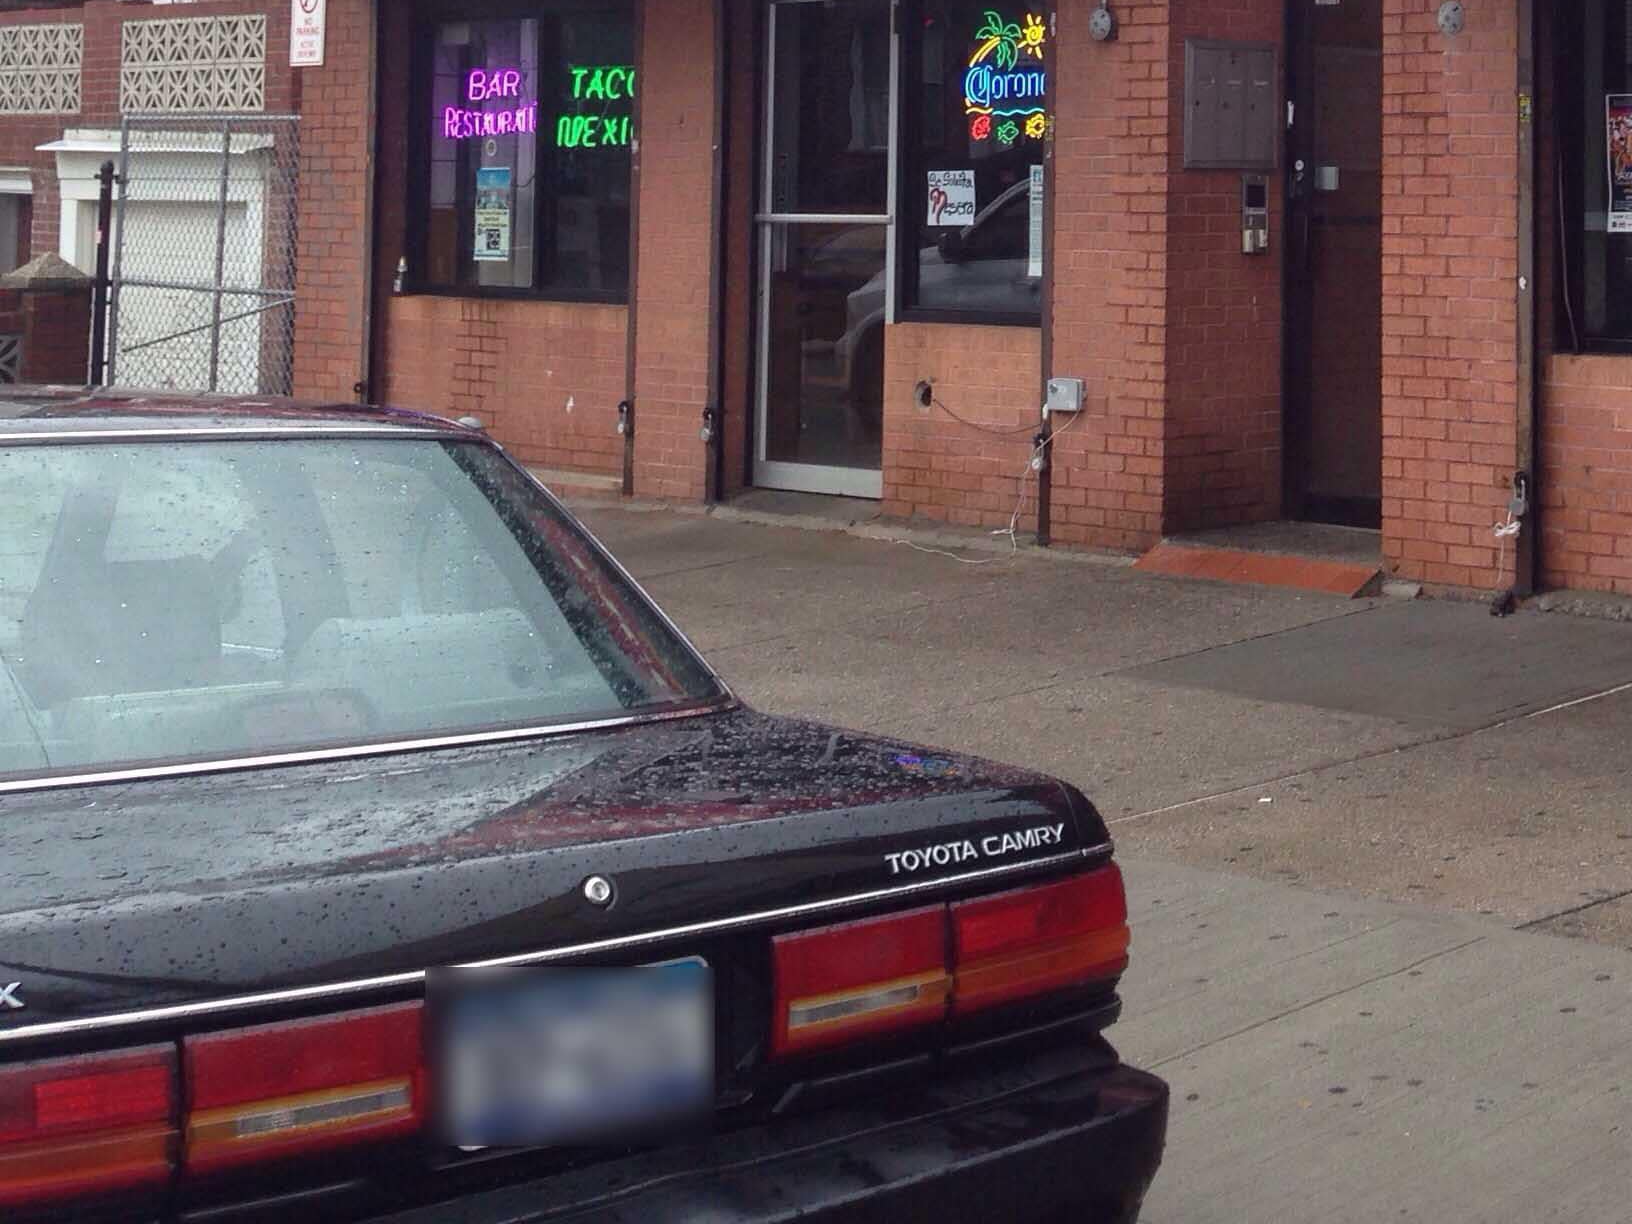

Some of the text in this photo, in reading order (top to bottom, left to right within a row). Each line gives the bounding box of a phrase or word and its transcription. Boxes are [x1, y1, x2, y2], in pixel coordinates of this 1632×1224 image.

[468, 70, 520, 101] BAR
[557, 116, 635, 148] MEXI
[884, 823, 1065, 874] TOYOTA CAMRY
